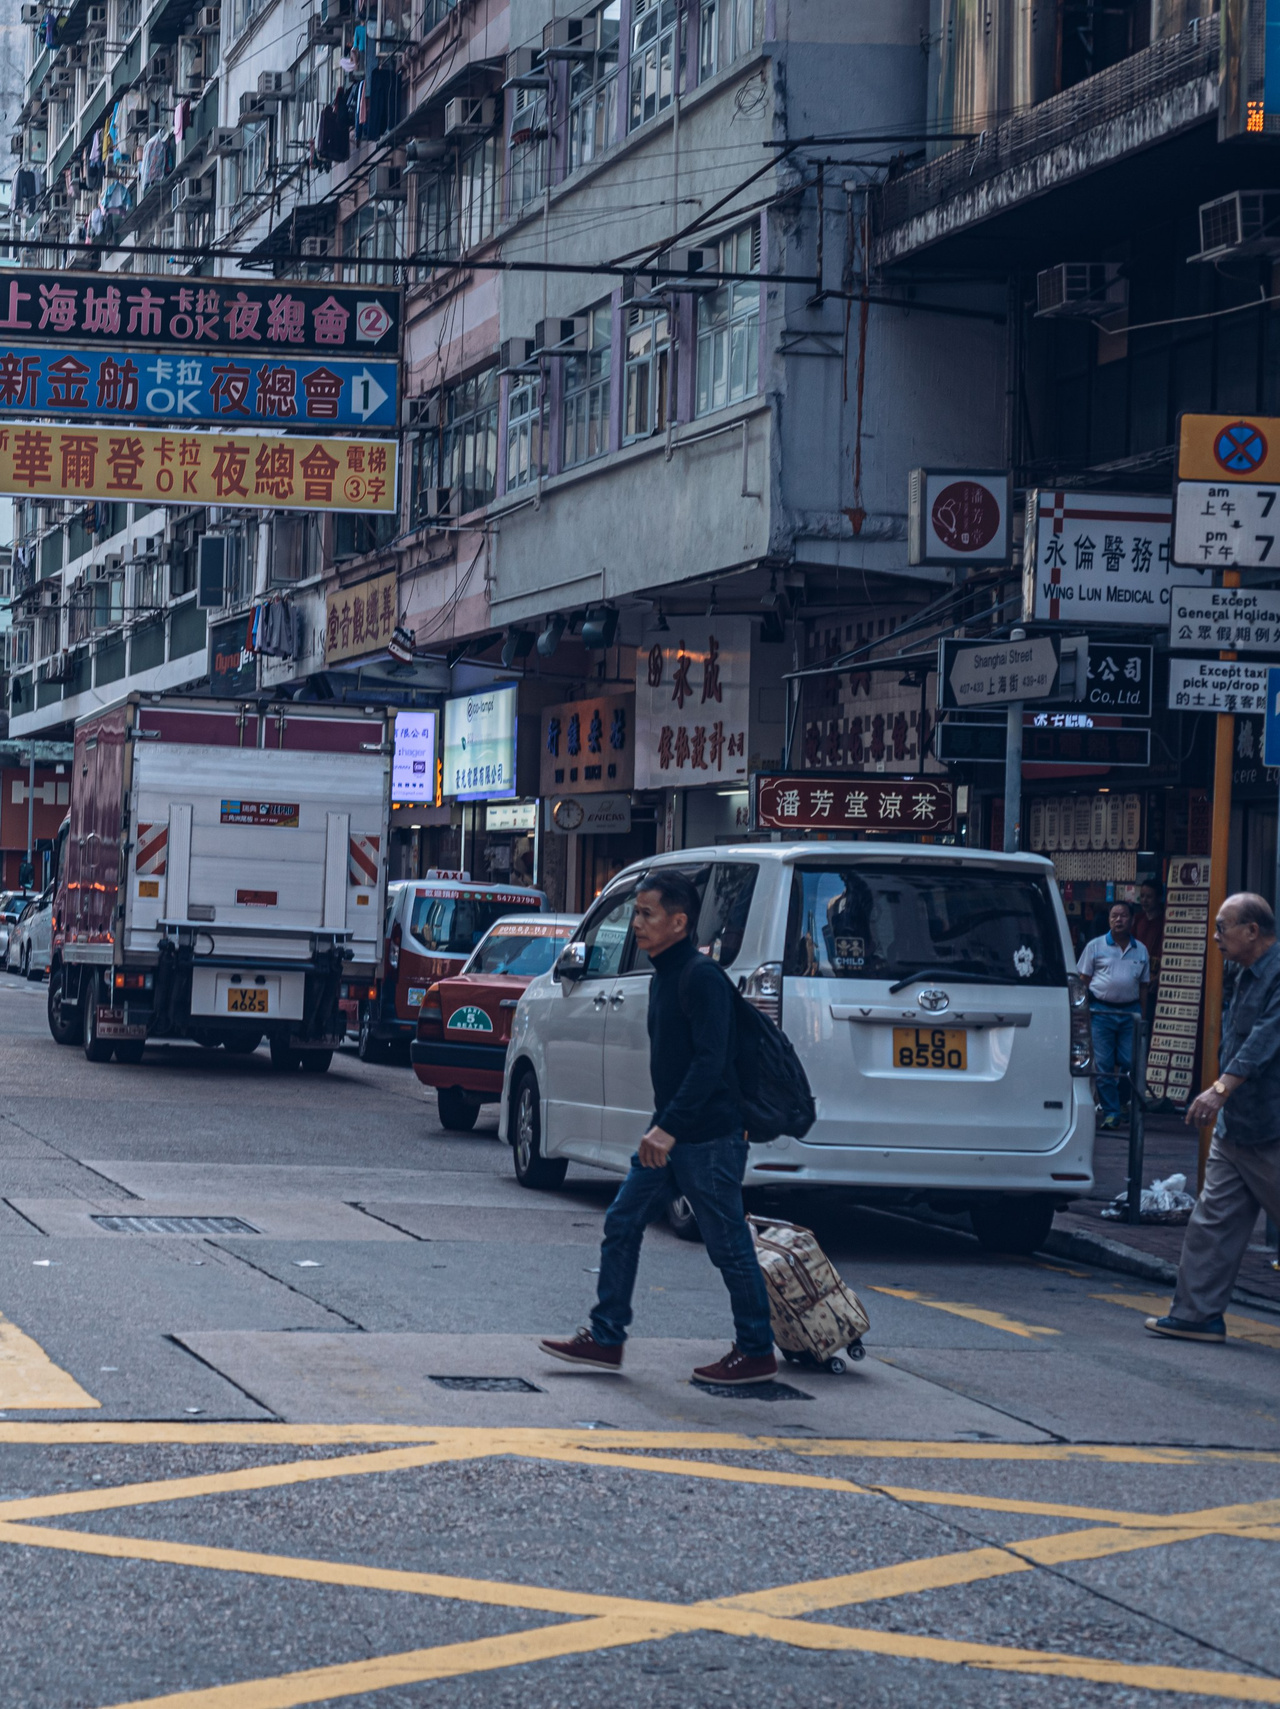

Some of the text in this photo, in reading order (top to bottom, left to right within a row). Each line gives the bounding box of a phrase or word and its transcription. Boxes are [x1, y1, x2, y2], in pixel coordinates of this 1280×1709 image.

[169, 288, 220, 313] 卡拉
[169, 314, 220, 341] OK
[223, 291, 351, 345] 夜總會
[146, 358, 203, 386] 卡拉
[209, 362, 345, 419] 夜總會
[360, 380, 371, 410] 1
[145, 388, 202, 415] OK
[154, 437, 202, 467] 卡拉
[155, 469, 198, 494] OK
[211, 441, 341, 501] 夜總會
[1200, 501, 1236, 517] 上午
[1208, 487, 1277, 518] am 7
[1199, 545, 1234, 561] 下午
[1206, 531, 1275, 562] pm 7
[1212, 594, 1257, 609] Except
[1177, 606, 1229, 621] General
[974, 648, 1033, 670] Shanghai Street
[1199, 664, 1243, 678] Except
[986, 673, 1019, 696] 上海街
[1182, 677, 1260, 694] pick up/drop
[776, 789, 937, 821] 潘芳堂涼茶
[436, 871, 463, 880] TAXI
[835, 957, 865, 966] CHILD
[230, 999, 266, 1012] 4665
[239, 989, 257, 1001] VJ
[461, 1007, 481, 1015] TAXI
[467, 1013, 475, 1024] 5
[456, 1022, 484, 1030] SEATS
[914, 1029, 946, 1050] LG
[899, 1048, 962, 1069] 8590
